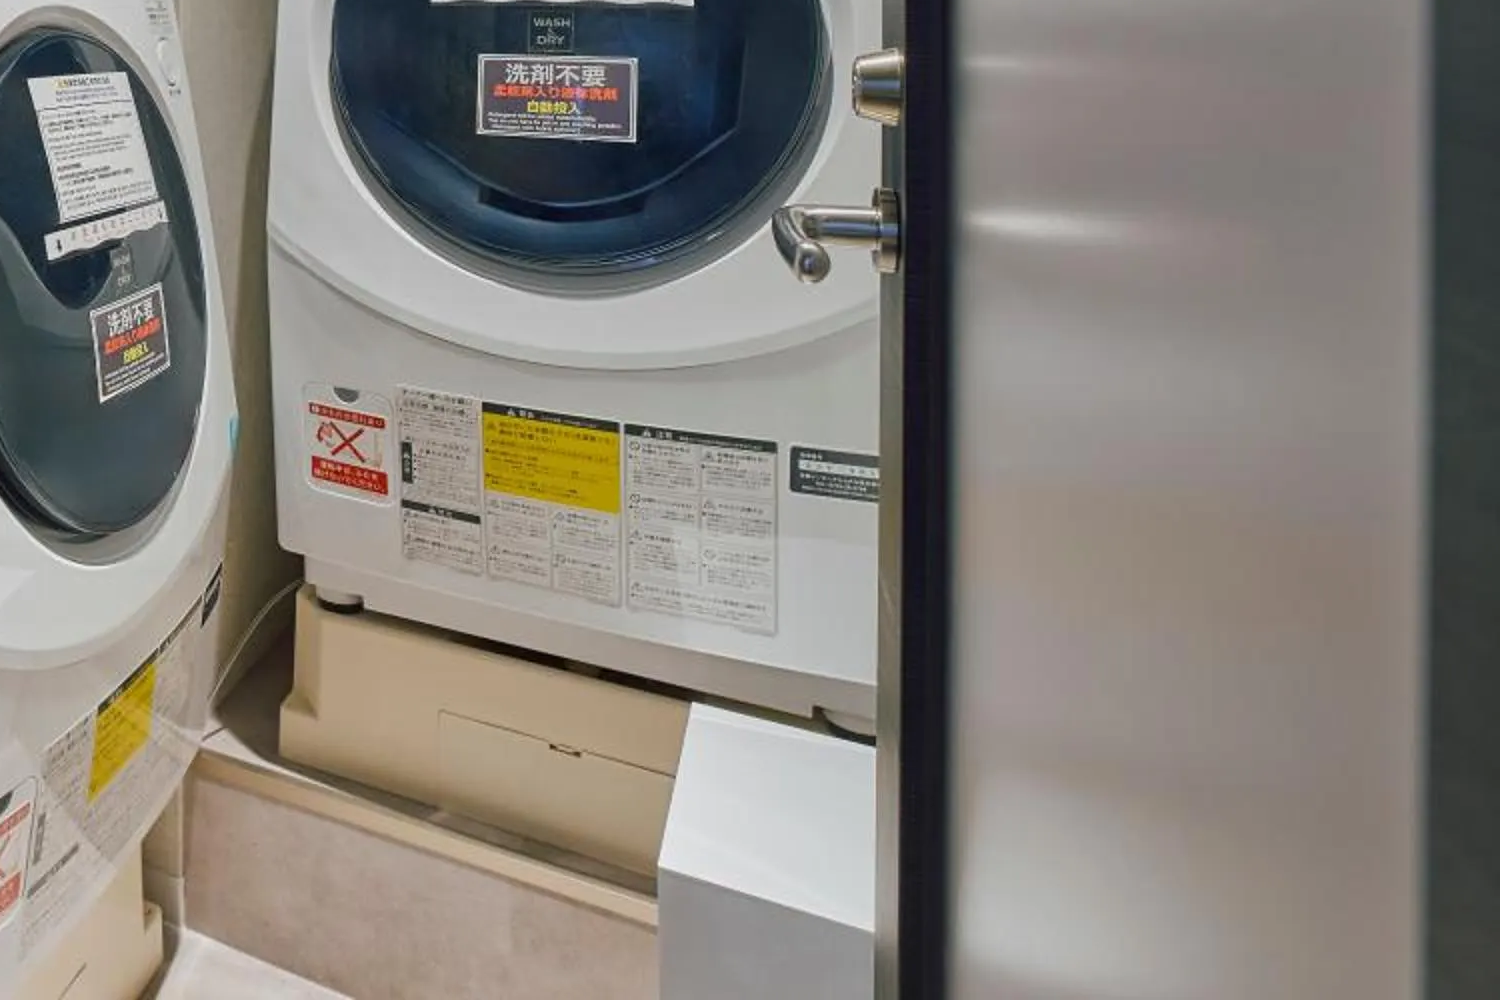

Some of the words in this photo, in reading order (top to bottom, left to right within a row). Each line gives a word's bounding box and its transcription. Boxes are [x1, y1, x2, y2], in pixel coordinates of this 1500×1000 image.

[533, 17, 571, 27] WASH
[537, 35, 565, 45] DRY
[505, 63, 607, 87] 洗剤不要
[527, 100, 579, 115] 自動投入
[107, 297, 153, 336] 洗剤不要
